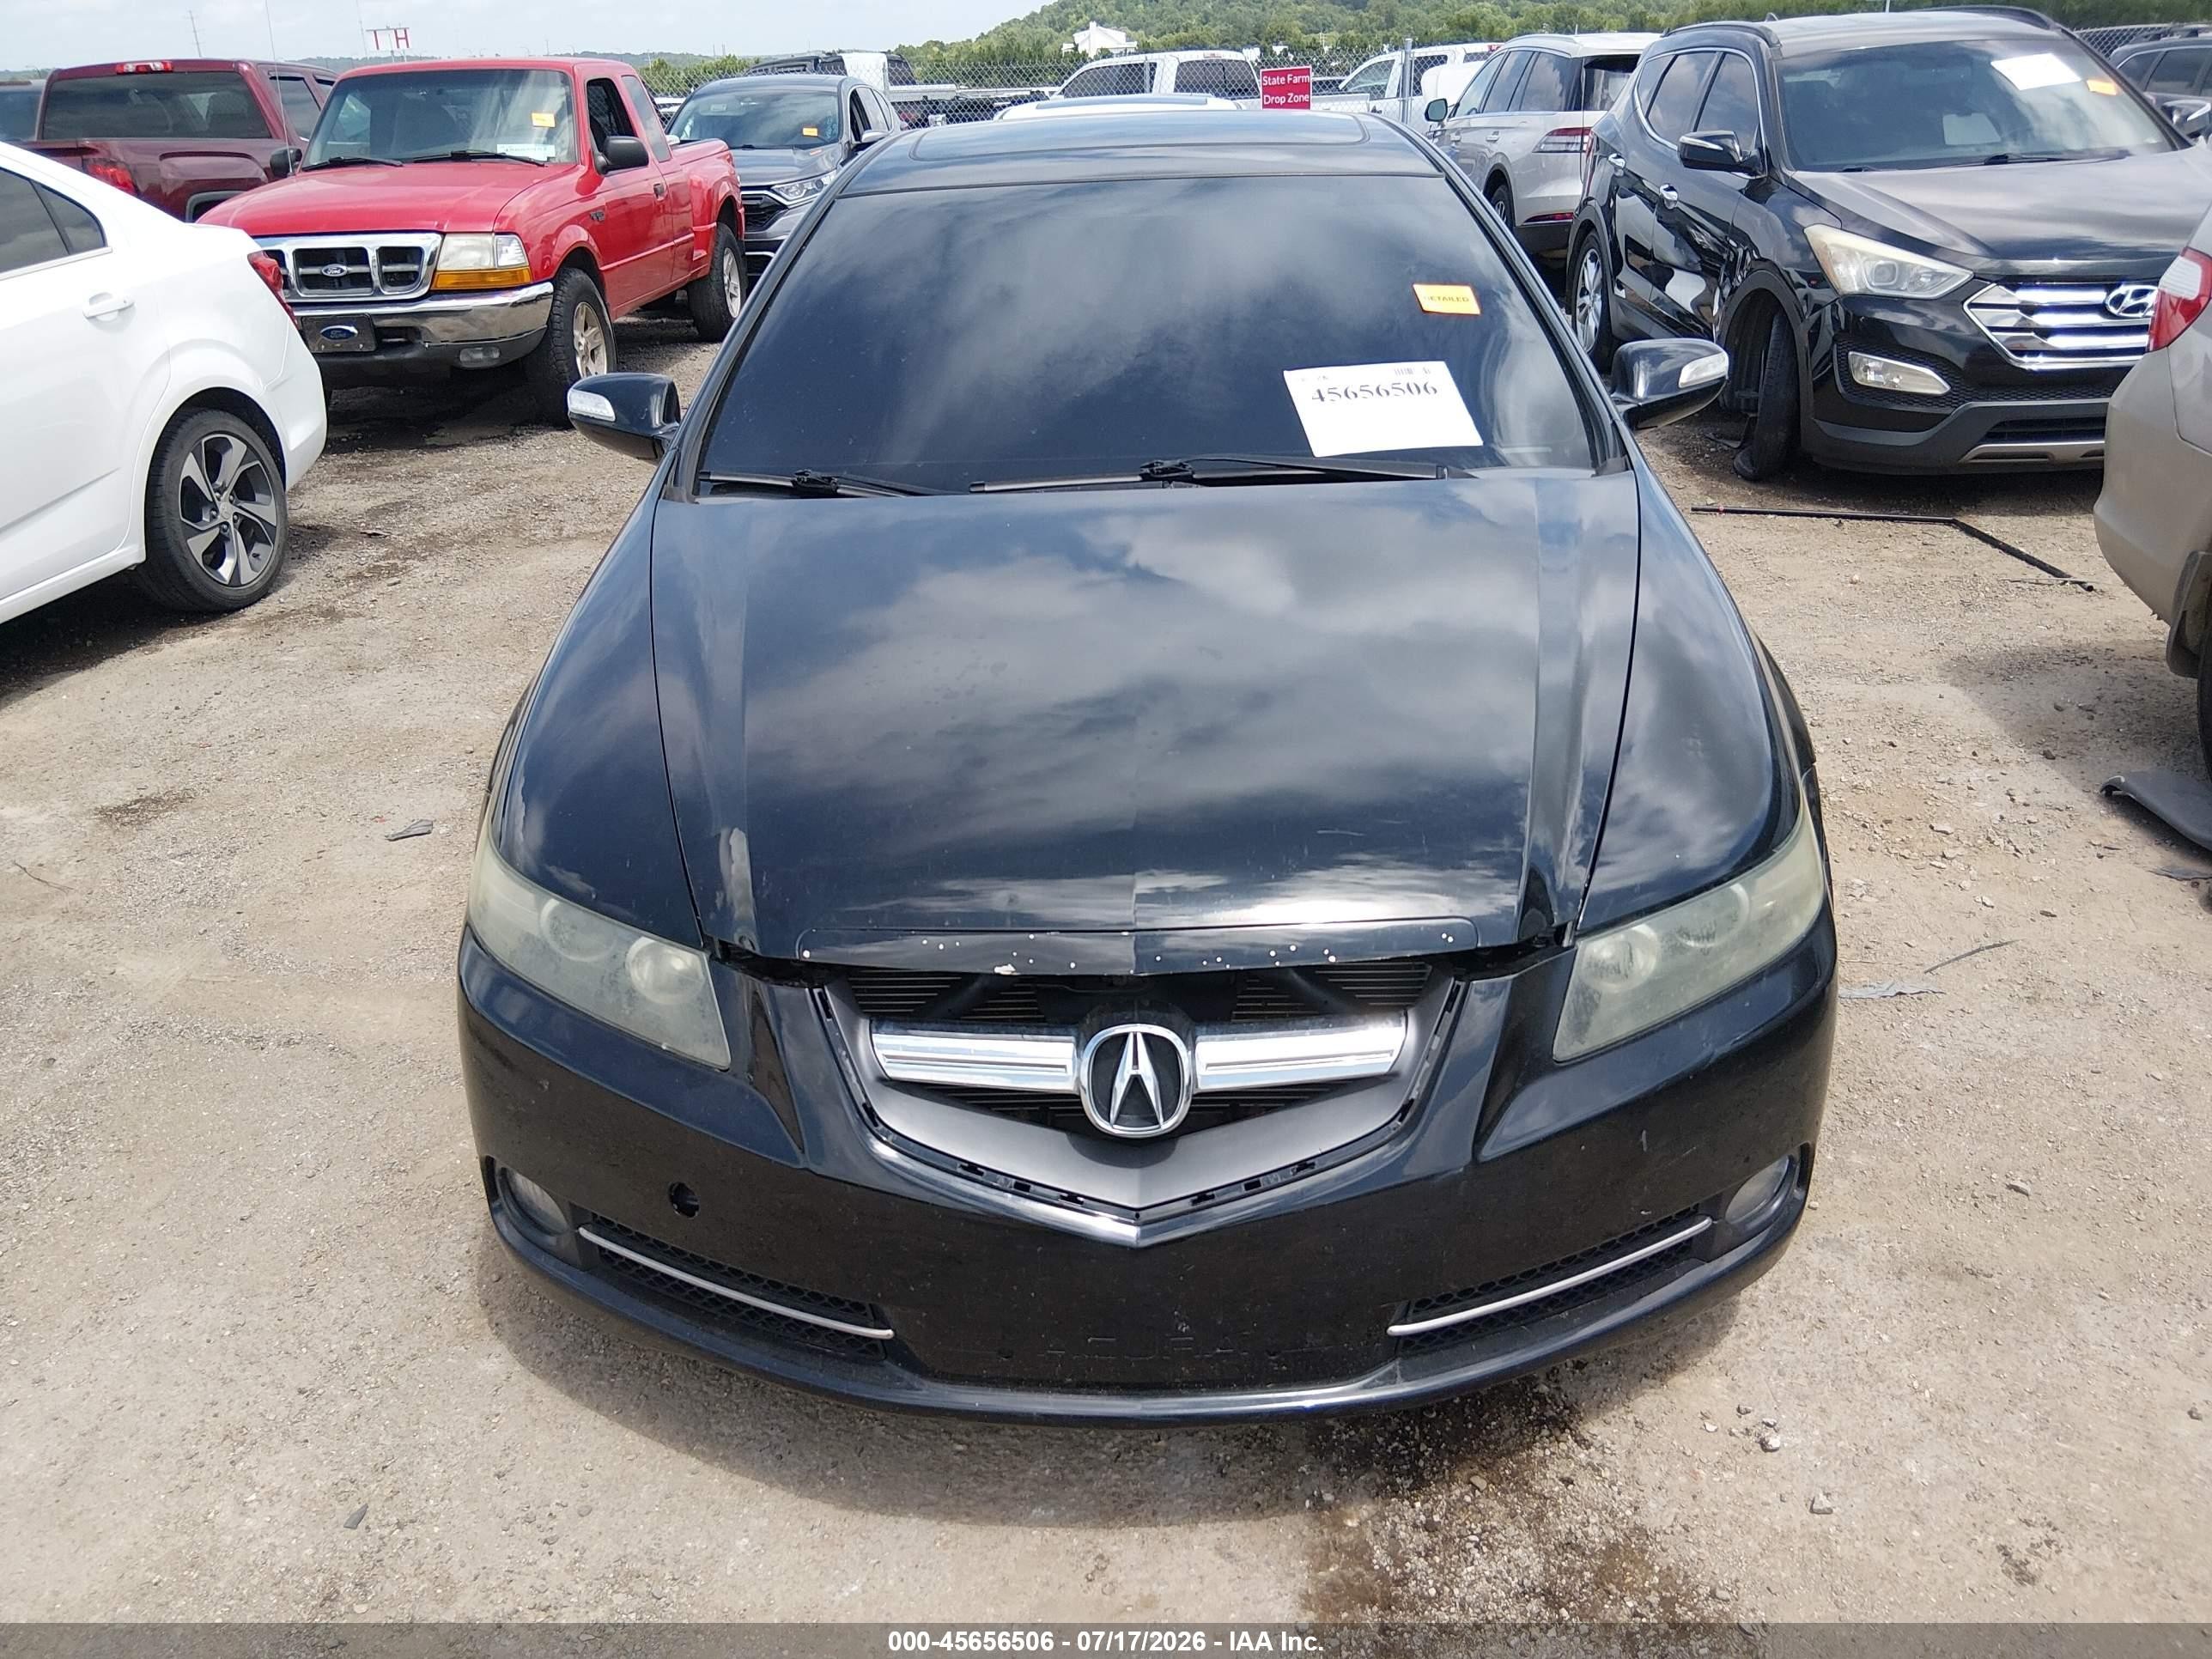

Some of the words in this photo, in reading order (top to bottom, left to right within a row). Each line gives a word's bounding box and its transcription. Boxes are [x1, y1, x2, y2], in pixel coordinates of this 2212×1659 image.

[1262, 75, 1285, 86] State
[1286, 74, 1310, 84] Farm
[1263, 94, 1286, 106] Drop
[1286, 92, 1310, 103] Zone
[1312, 381, 1438, 403] 45656506
